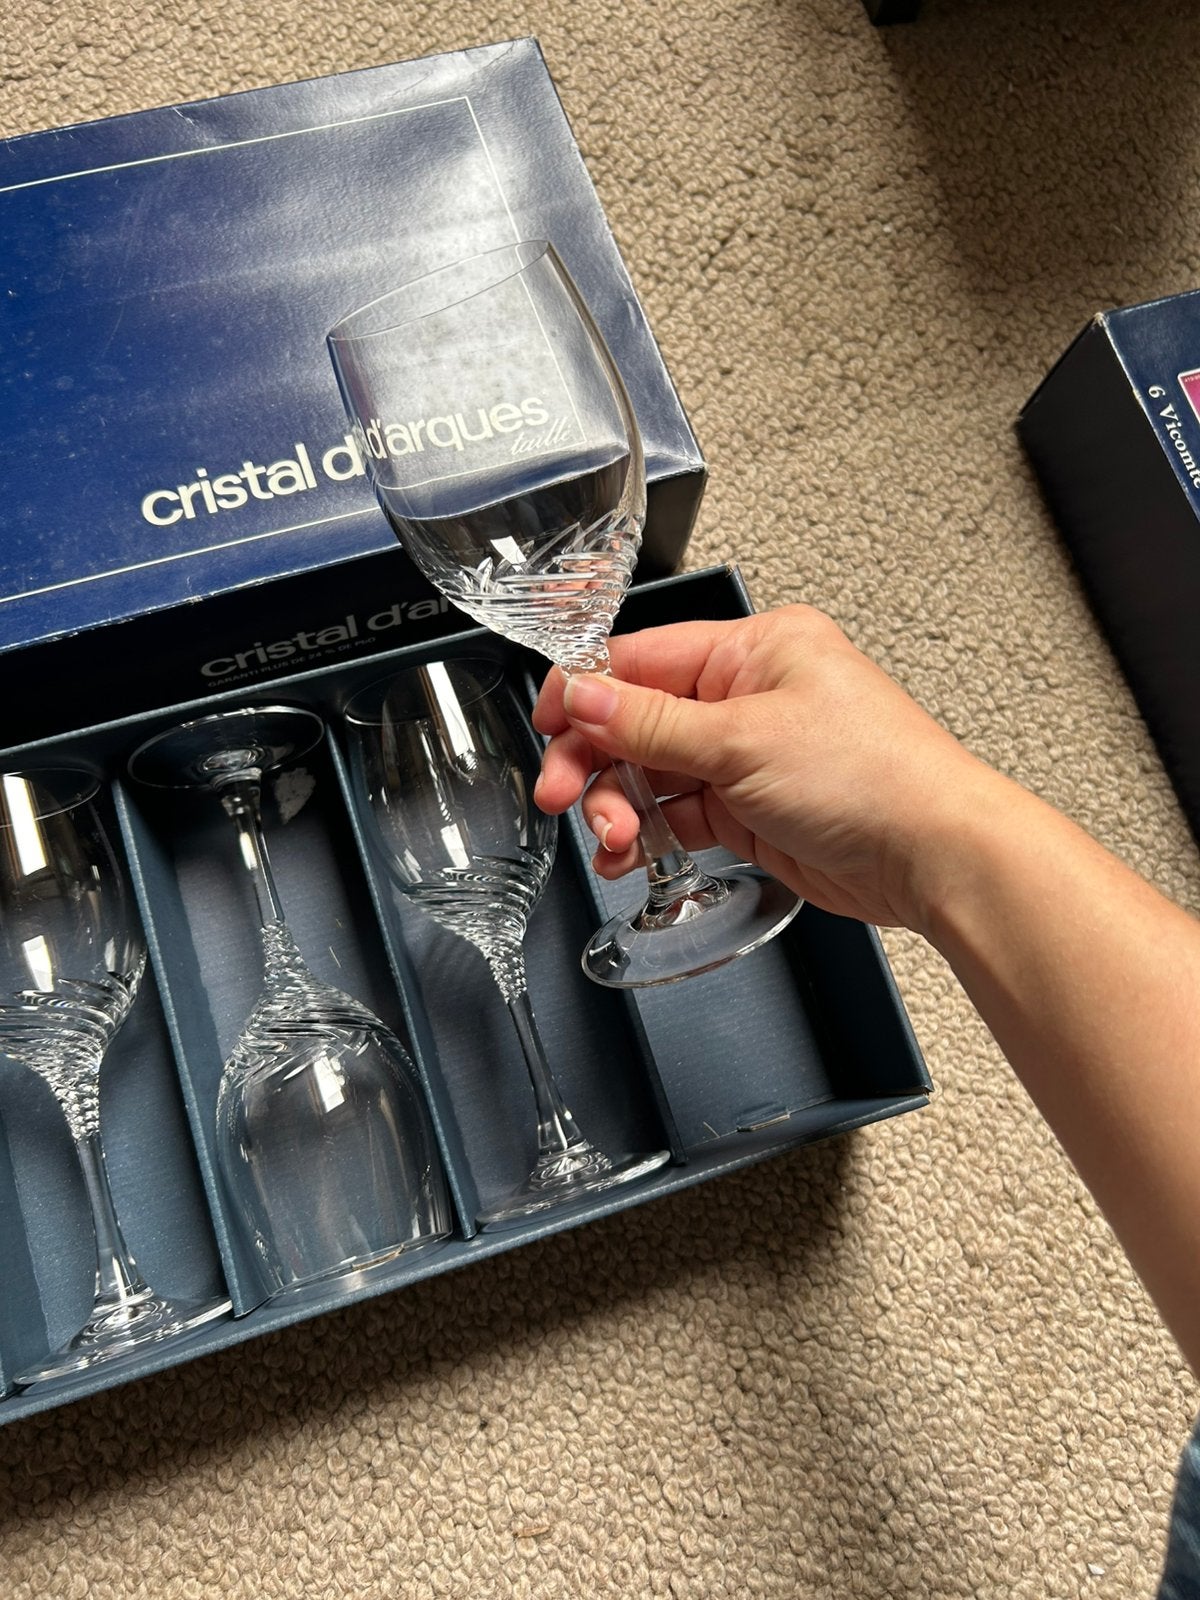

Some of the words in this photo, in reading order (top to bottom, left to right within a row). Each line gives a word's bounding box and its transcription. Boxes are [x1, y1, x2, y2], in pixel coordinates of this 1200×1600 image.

[1148, 385, 1166, 399] 6
[141, 442, 318, 527] cristal
[200, 614, 359, 678] cristal
[207, 669, 259, 688] GARANTI
[260, 661, 289, 673] PLUS
[290, 656, 306, 665] DE
[308, 651, 323, 661] 24
[337, 644, 353, 652] DE
